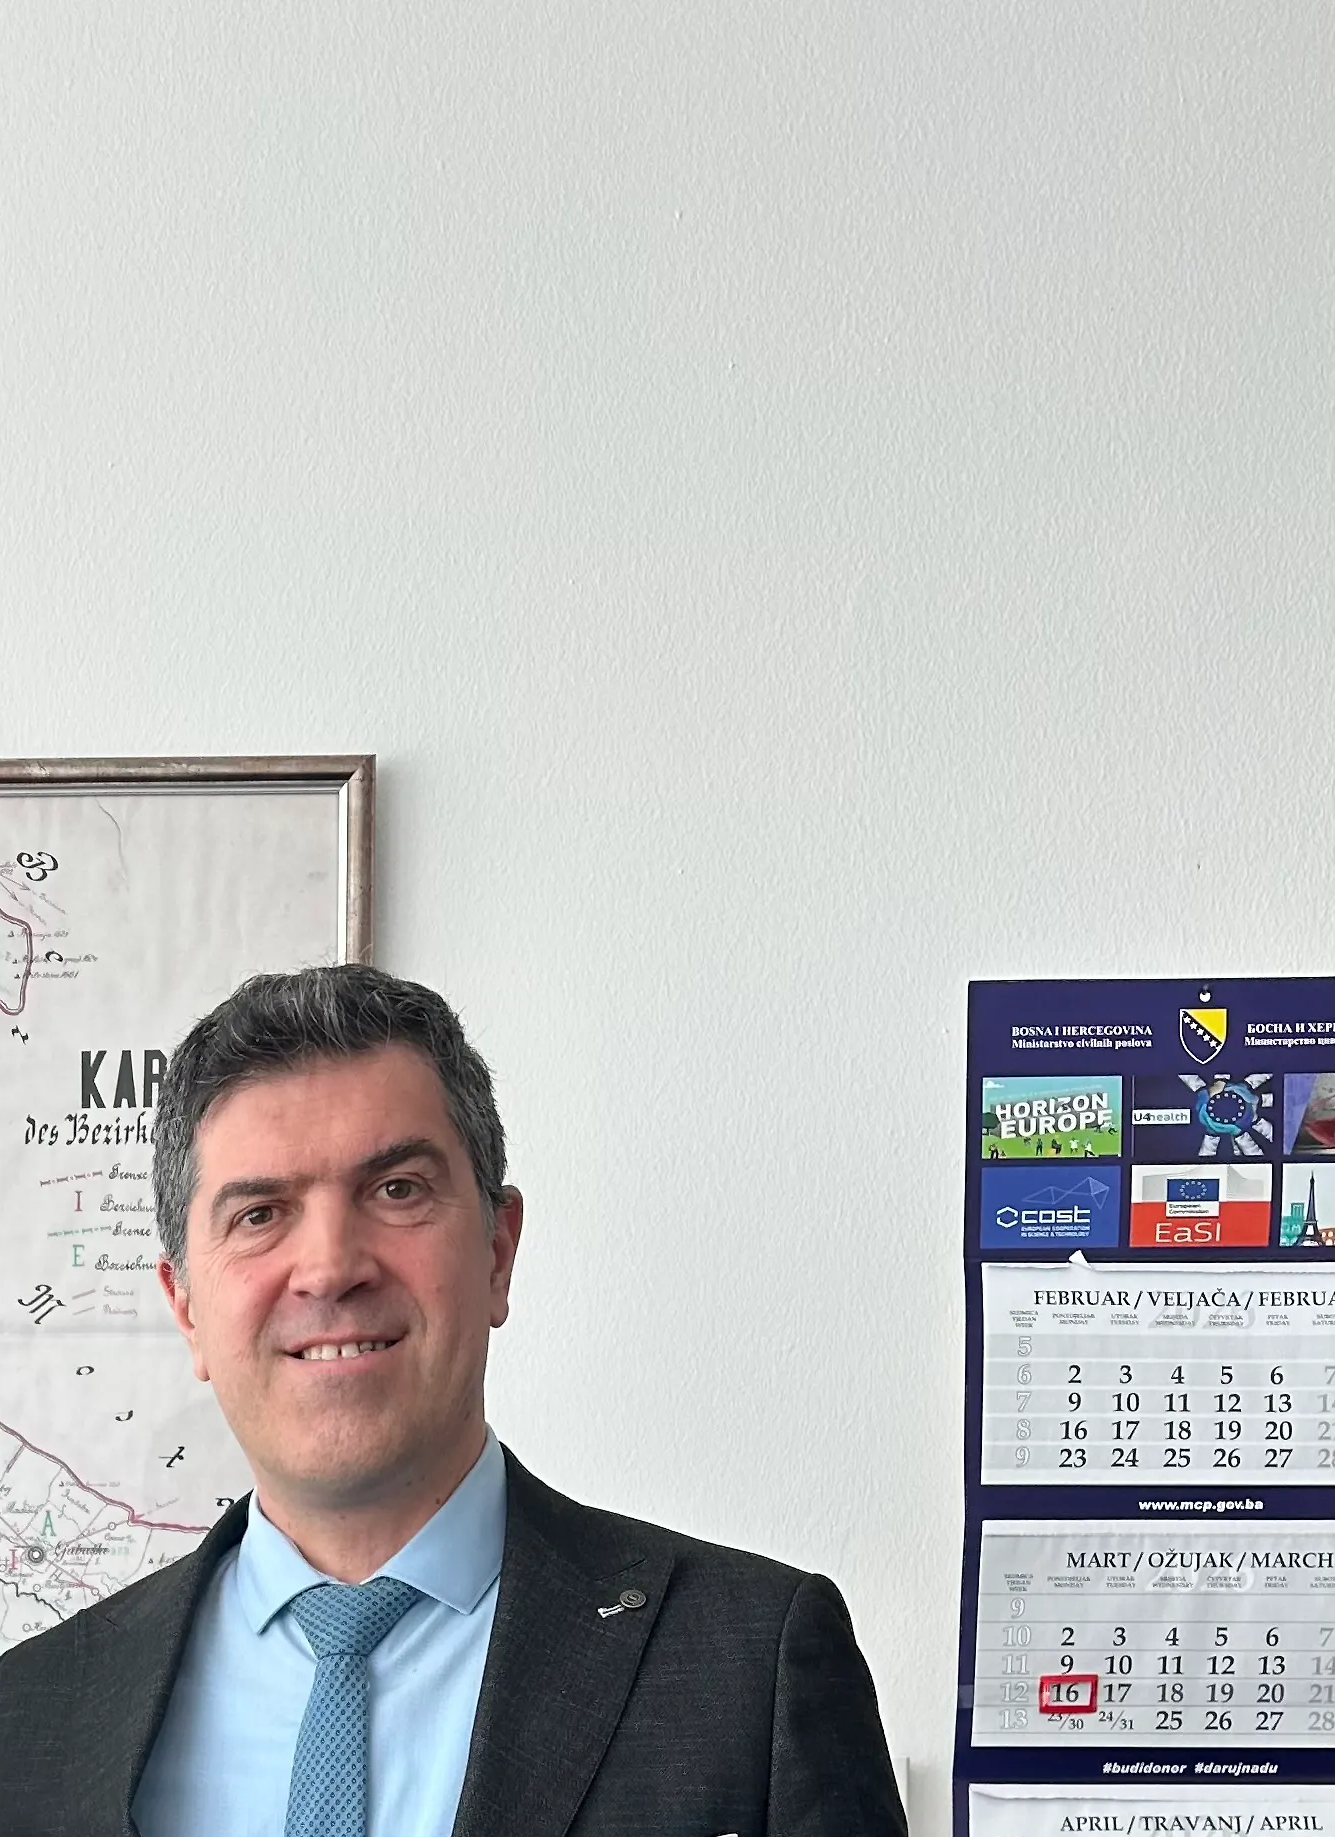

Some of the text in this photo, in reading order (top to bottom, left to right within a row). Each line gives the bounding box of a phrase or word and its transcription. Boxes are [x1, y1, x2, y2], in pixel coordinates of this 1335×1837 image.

[1012, 1025, 1153, 1037] BOSNA I HERCEGOVINA
[1248, 1023, 1293, 1034] БОСНА
[1295, 1023, 1305, 1033] И
[1115, 1037, 1152, 1050] poslova
[996, 1092, 1109, 1122] HORIZON
[25, 1113, 59, 1146] des
[999, 1109, 1115, 1139] EUROPE
[1155, 1222, 1221, 1243] EaSI
[1034, 1290, 1131, 1306] FEBRUAR
[1147, 1287, 1241, 1310] VELJAČA
[1017, 1336, 1032, 1357] 5
[1017, 1364, 1032, 1385] 6
[1068, 1365, 1081, 1383] 2
[1120, 1365, 1132, 1383] 3
[1171, 1366, 1184, 1384] 4
[1221, 1366, 1233, 1384] 5
[1271, 1366, 1283, 1384] 6
[1016, 1391, 1291, 1413] 7 9 10 11 12 13
[1016, 1419, 1292, 1440] 8 16 17 18 19 20
[1015, 1446, 1293, 1468] 9 23 24 25 26 27
[1138, 1499, 1264, 1513] www.mcp.gov.ba
[1067, 1548, 1335, 1573] MART OŽUJAK MARCH
[1010, 1597, 1026, 1619] 9
[1002, 1624, 1334, 1647] 10 2 3 4 5 6 7
[1001, 1652, 1335, 1675] 11 9 10 11 12 13 14
[1000, 1680, 1333, 1703] 12 16 17 18 19 20 21
[999, 1708, 1029, 1729] 13
[1156, 1711, 1182, 1730] 25
[1205, 1711, 1232, 1730] 26
[1256, 1711, 1283, 1730] 27
[1309, 1712, 1335, 1730] 28
[1102, 1761, 1279, 1777] #budidonor #darujnadu
[1060, 1815, 1324, 1834] APRIL TRAVANJ APRIL
